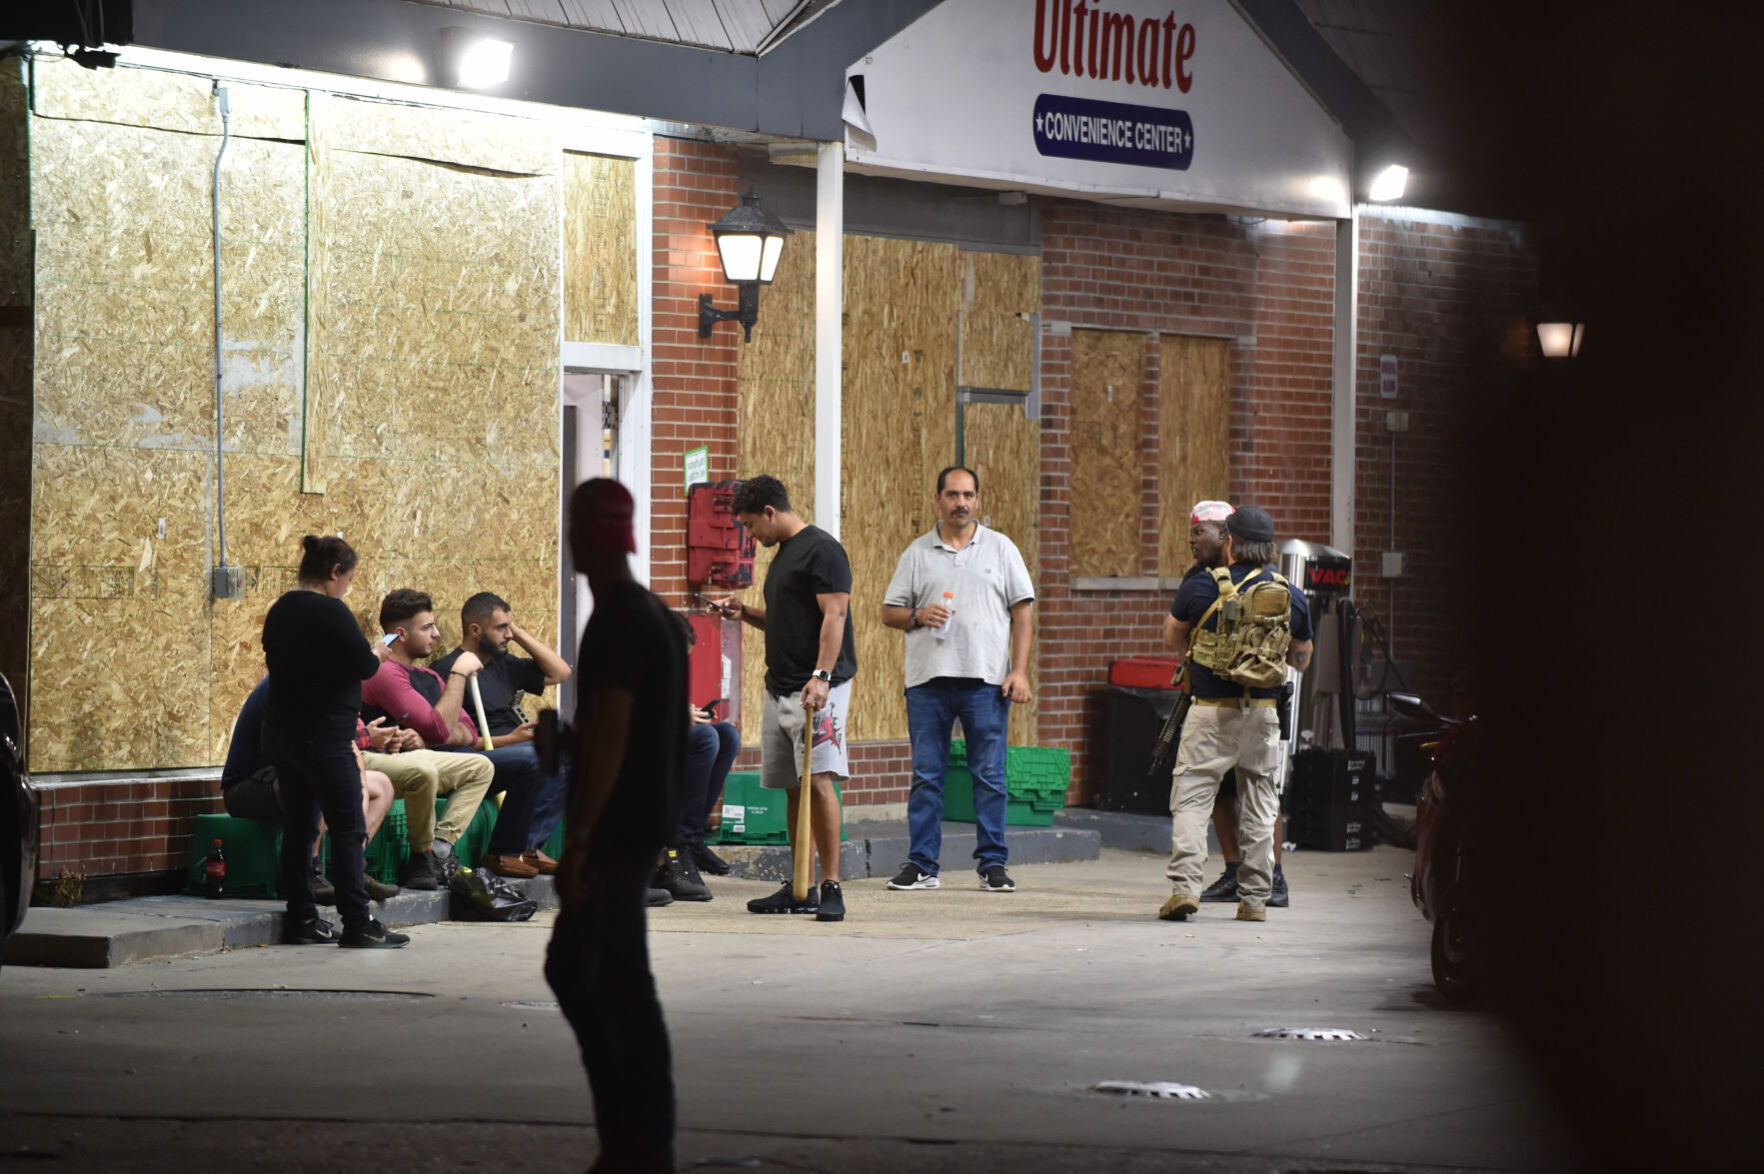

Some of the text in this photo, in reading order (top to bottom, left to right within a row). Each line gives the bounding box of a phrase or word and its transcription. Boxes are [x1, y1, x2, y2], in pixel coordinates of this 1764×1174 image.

[1034, 0, 1195, 93] Ultimate
[1045, 112, 1183, 153] CONVENIENCE CENTER
[1309, 567, 1348, 585] VAC
